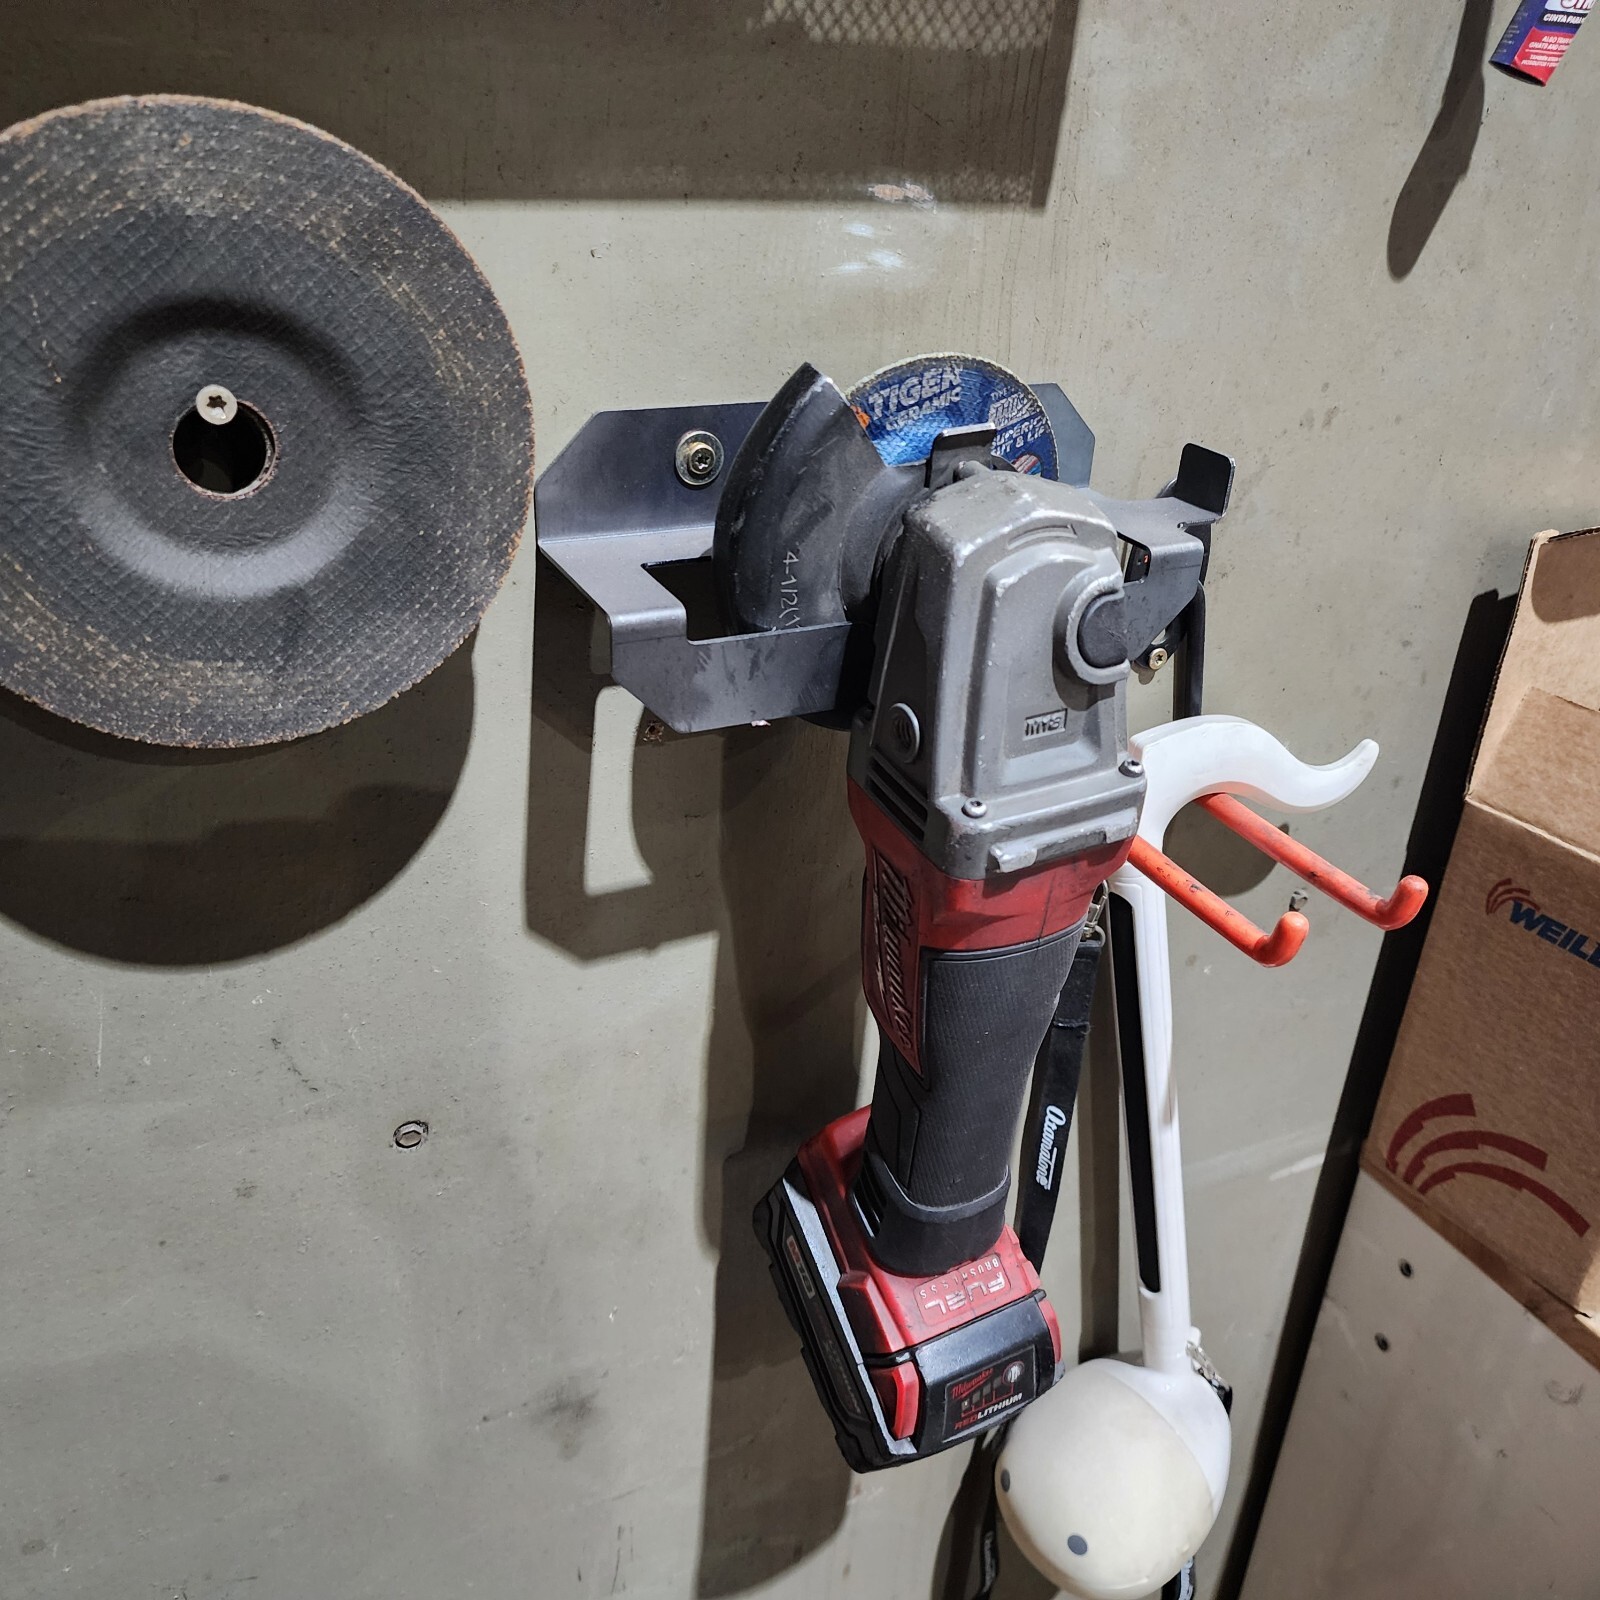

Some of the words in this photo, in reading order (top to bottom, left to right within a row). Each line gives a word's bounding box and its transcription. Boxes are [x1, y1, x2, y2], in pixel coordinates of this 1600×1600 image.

[1015, 435, 1024, 448] &
[1035, 1105, 1067, 1191] Otamatone
[924, 1271, 1006, 1315] FUEL
[951, 1367, 994, 1399] Milwaukee
